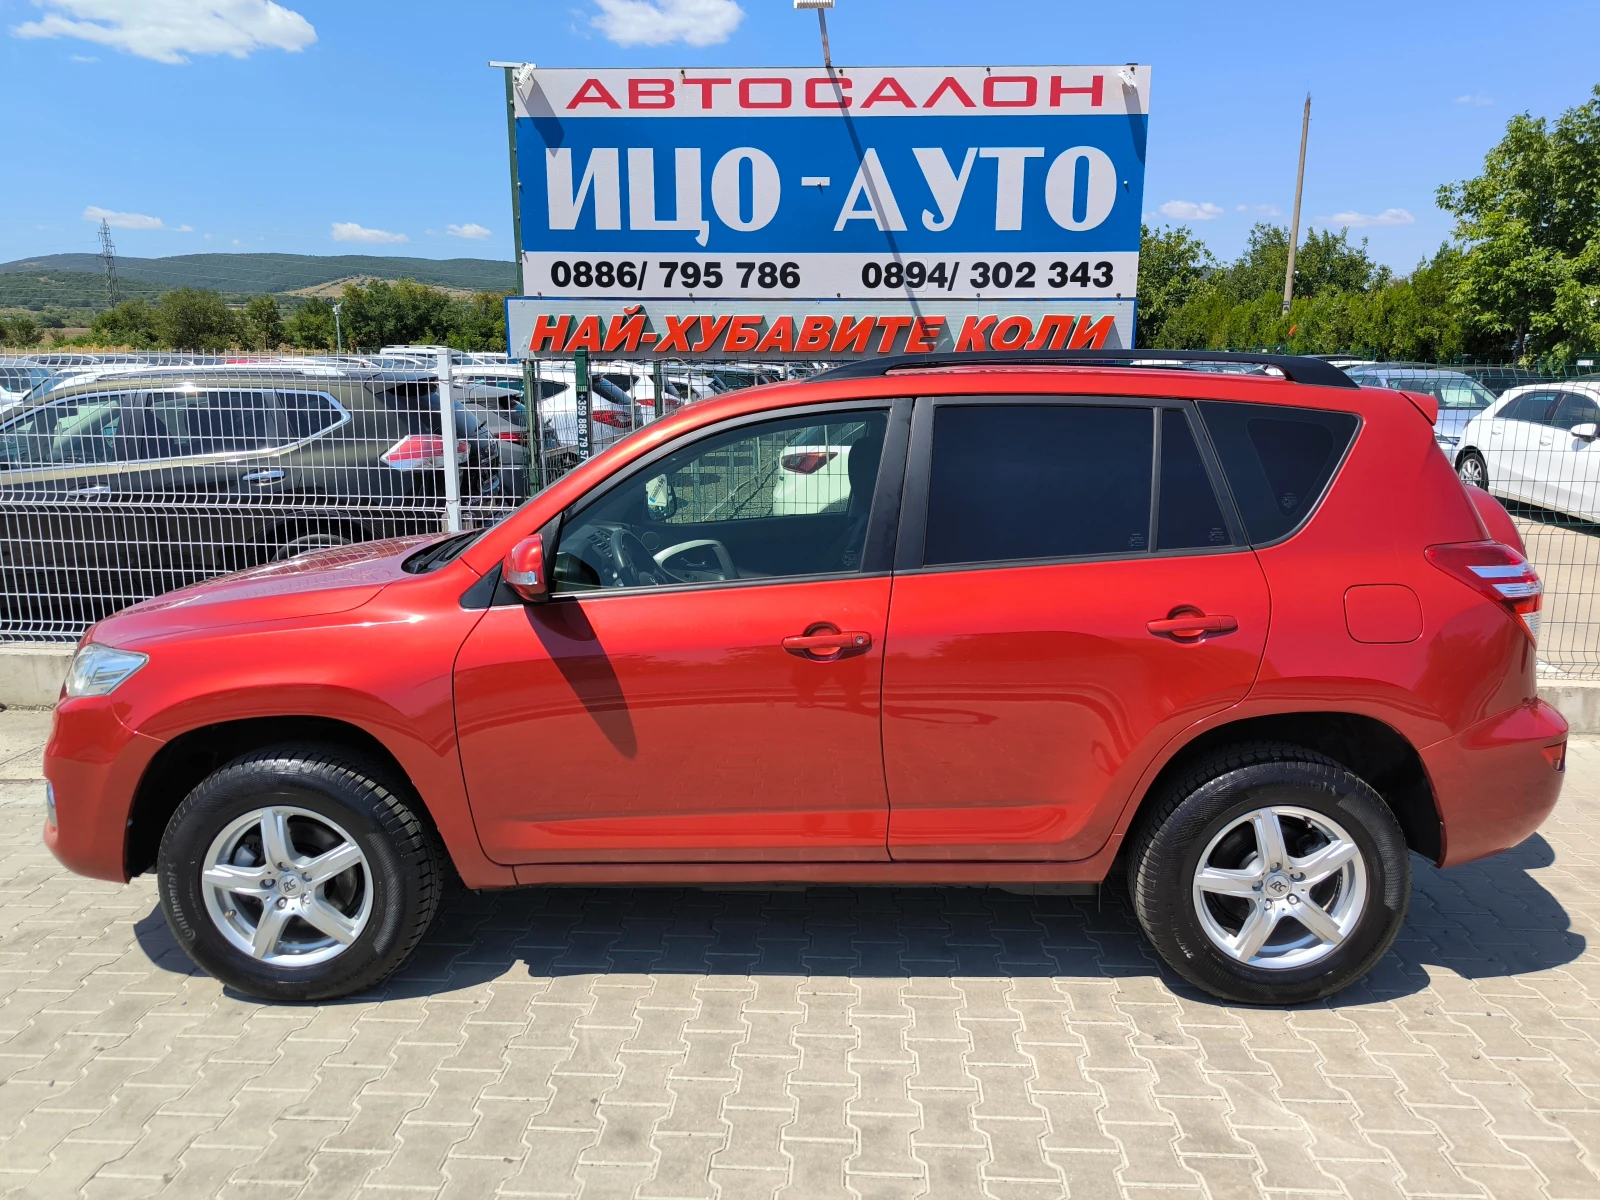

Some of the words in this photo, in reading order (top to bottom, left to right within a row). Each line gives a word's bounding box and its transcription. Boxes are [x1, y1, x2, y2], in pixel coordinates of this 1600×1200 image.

[566, 75, 1105, 112] АВТОСАЛОН
[551, 261, 647, 291] 0886/
[659, 261, 723, 289] 795
[736, 261, 800, 289] 786
[861, 261, 960, 291] 0894/
[970, 261, 1036, 289] 302
[1047, 261, 1114, 289] 343
[529, 304, 946, 353] НАЙ-ХУБАВИТЕ
[953, 314, 1115, 352] КОЛИ
[578, 418, 588, 434] 886
[579, 437, 589, 448] 79
